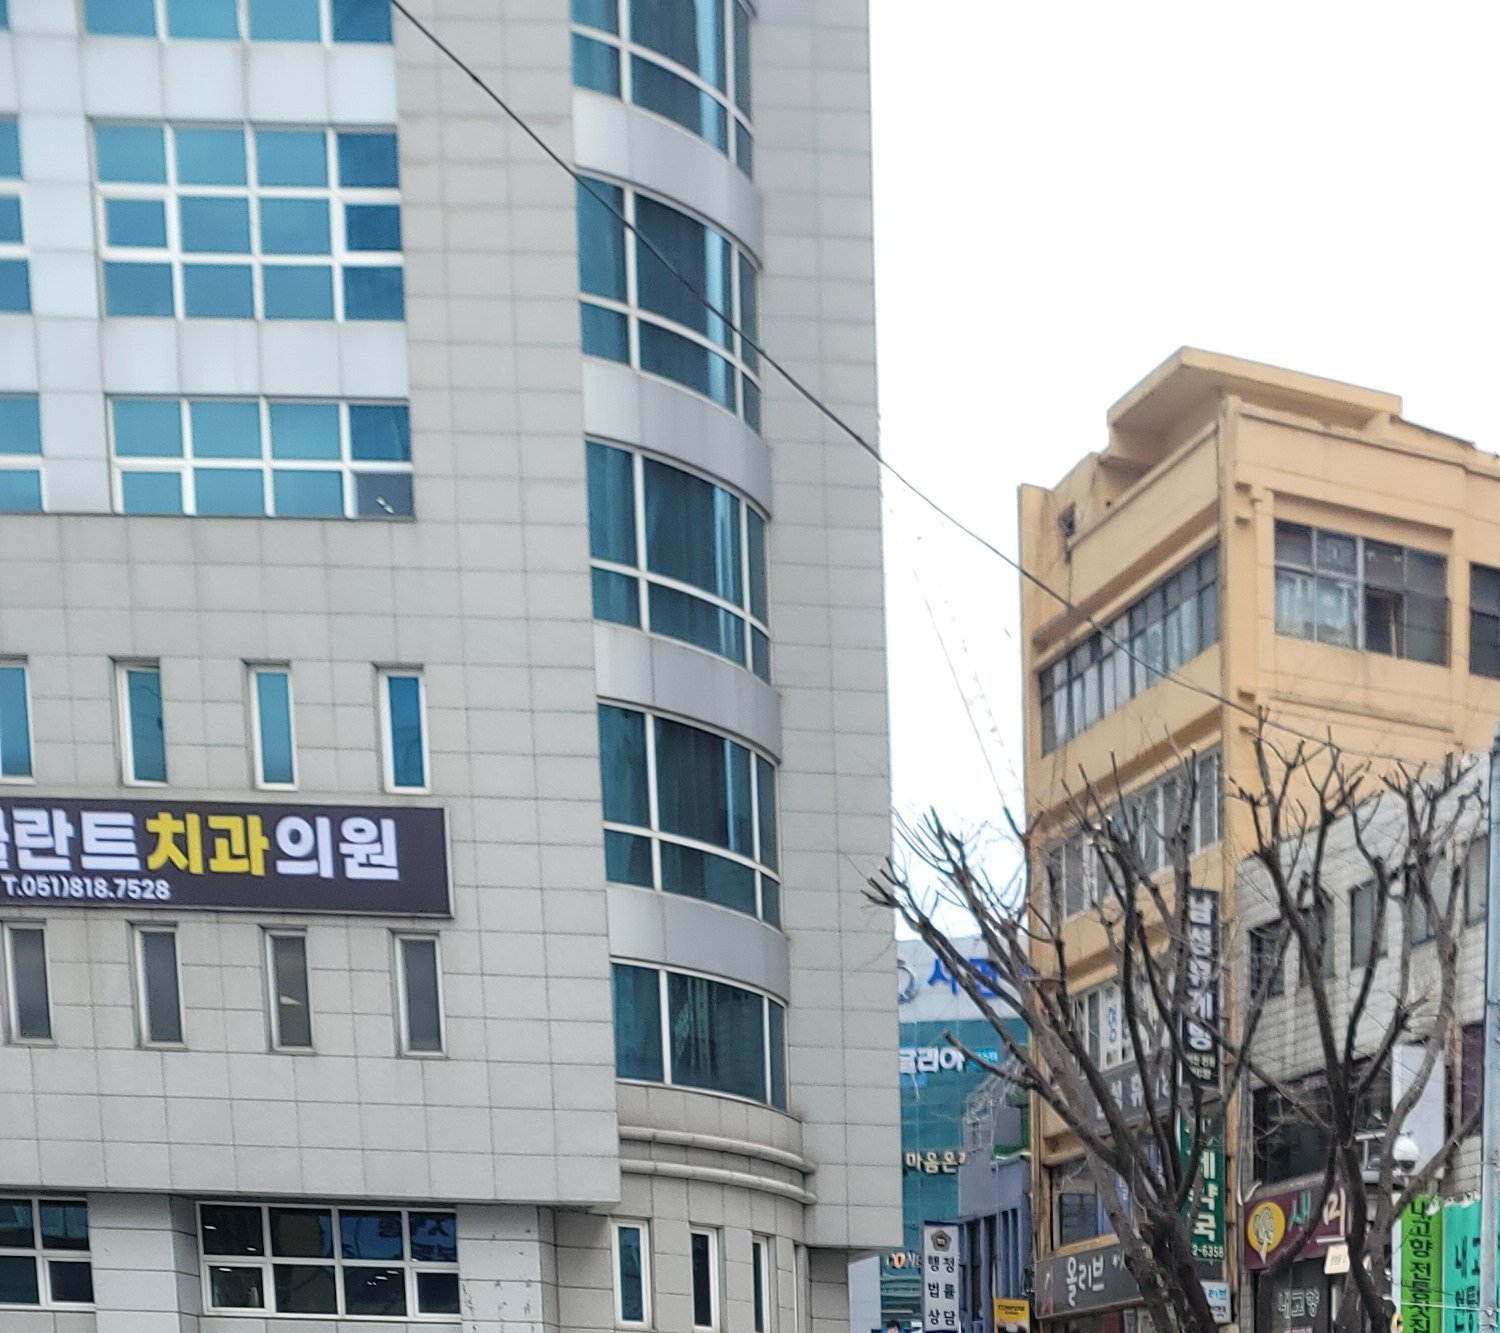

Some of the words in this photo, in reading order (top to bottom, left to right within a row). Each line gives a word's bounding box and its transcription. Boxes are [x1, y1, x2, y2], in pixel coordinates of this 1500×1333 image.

[3, 873, 172, 901] T.051)818.7528
[1066, 1256, 1105, 1307] 올리브
[927, 1308, 955, 1327] 상담
